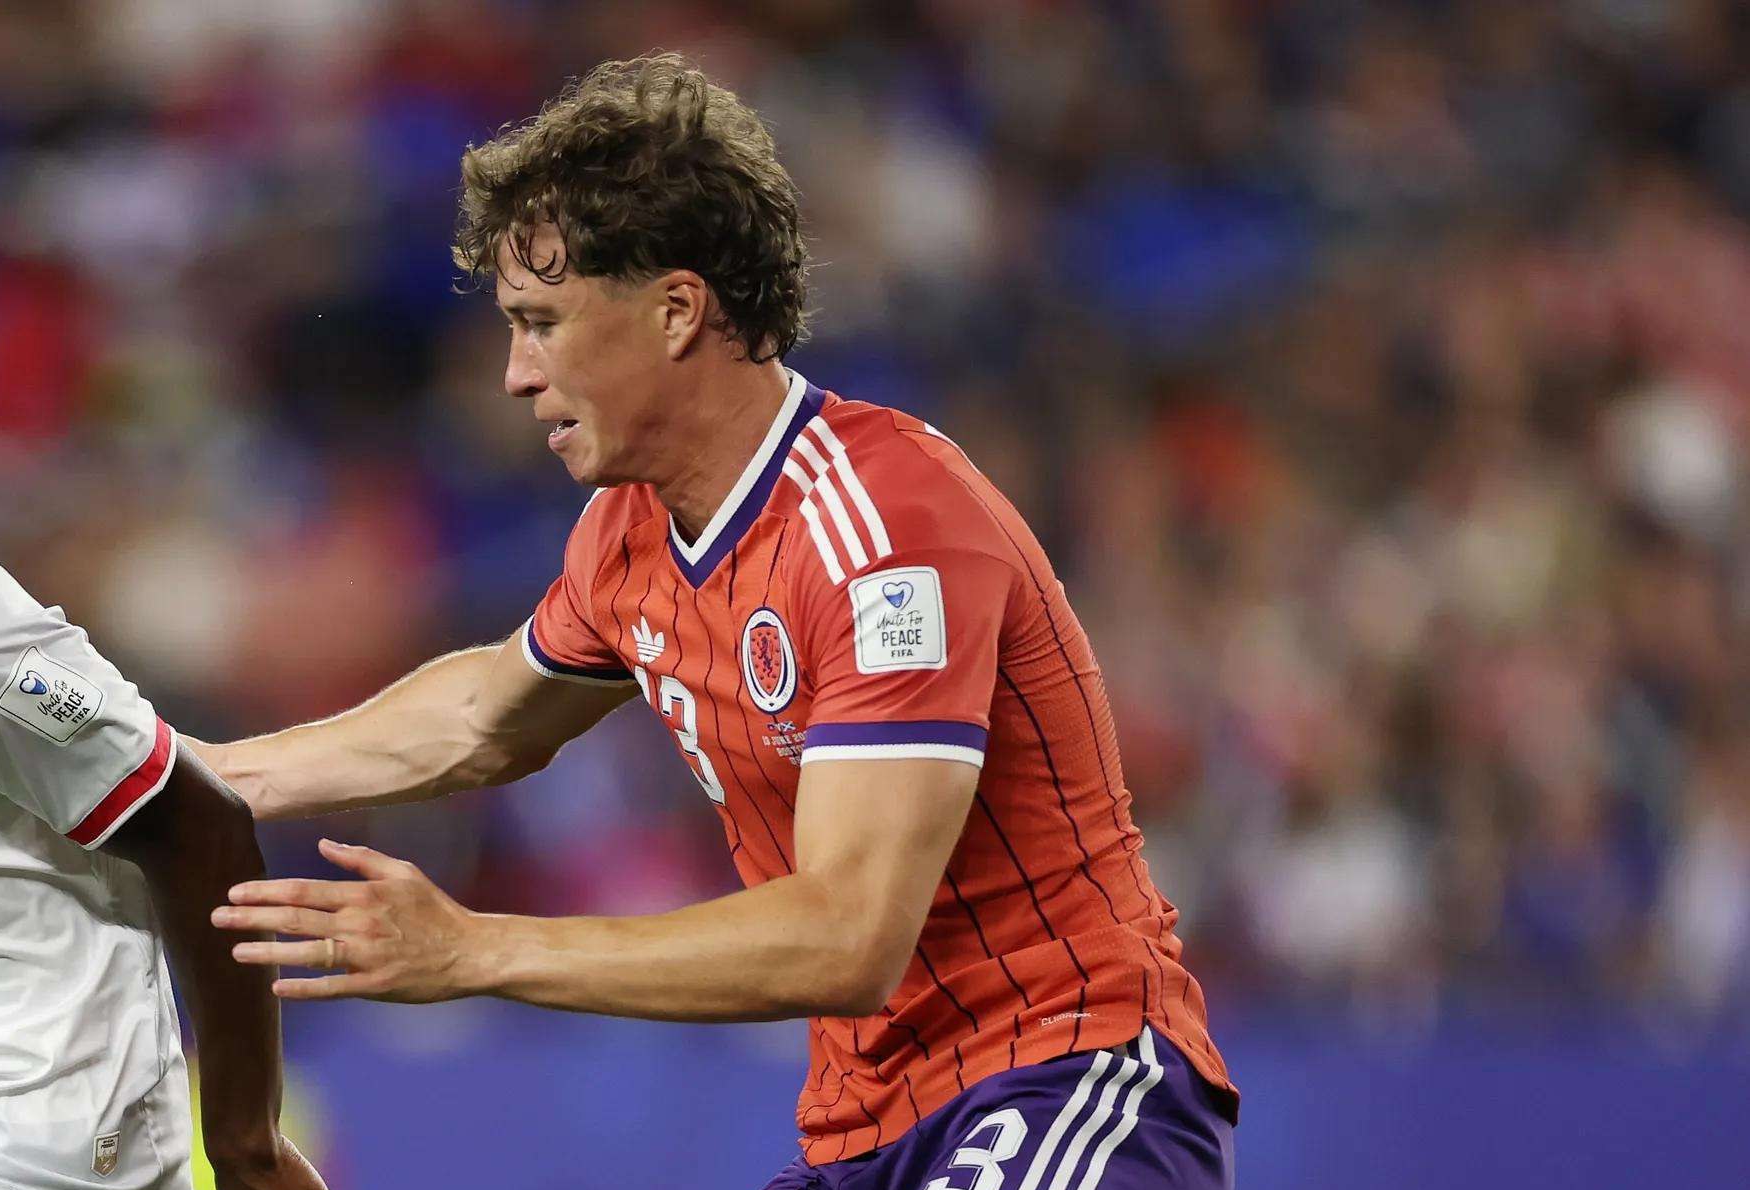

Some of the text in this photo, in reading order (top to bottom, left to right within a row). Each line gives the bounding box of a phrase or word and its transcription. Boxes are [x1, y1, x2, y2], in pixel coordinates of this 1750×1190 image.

[881, 628, 923, 648] PEACE
[891, 649, 914, 658] FIFA
[51, 688, 85, 723] PEACE
[70, 706, 91, 724] FIFA
